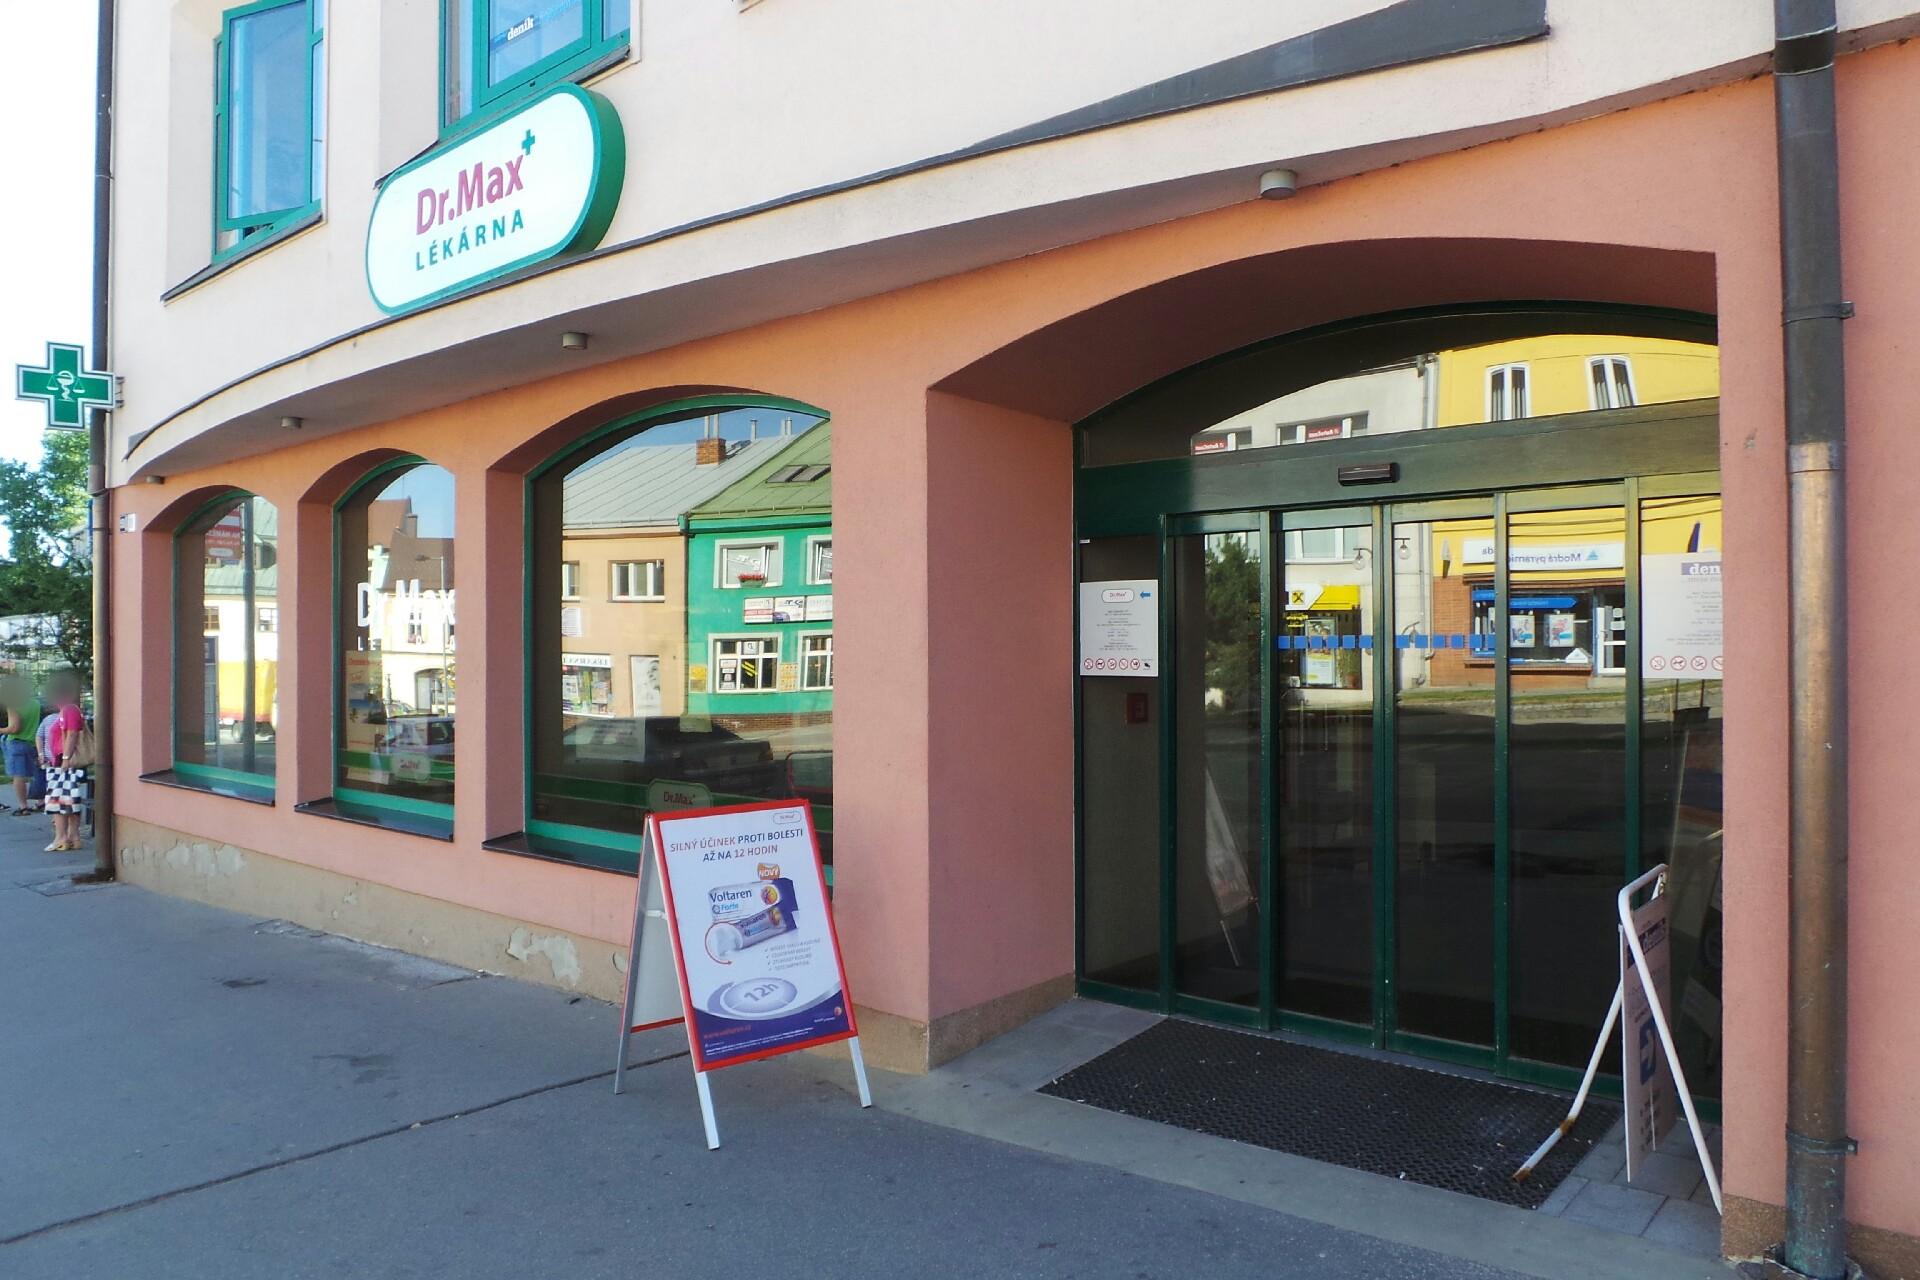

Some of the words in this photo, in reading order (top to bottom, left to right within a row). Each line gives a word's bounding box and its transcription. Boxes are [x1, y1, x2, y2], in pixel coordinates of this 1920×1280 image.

[415, 208, 524, 272] LÉKÁRNA
[1689, 563, 1721, 575] den
[670, 840, 698, 853] SILNÝ
[700, 836, 736, 849] ÚČINEK
[738, 832, 765, 844] PROTI
[767, 828, 803, 841] BOLESTI
[703, 851, 716, 862] AŽ
[718, 850, 732, 860] NA
[735, 848, 745, 859] 12
[747, 845, 778, 856] HODIN
[709, 889, 752, 903] Voltaren
[743, 982, 780, 1002] 12h
